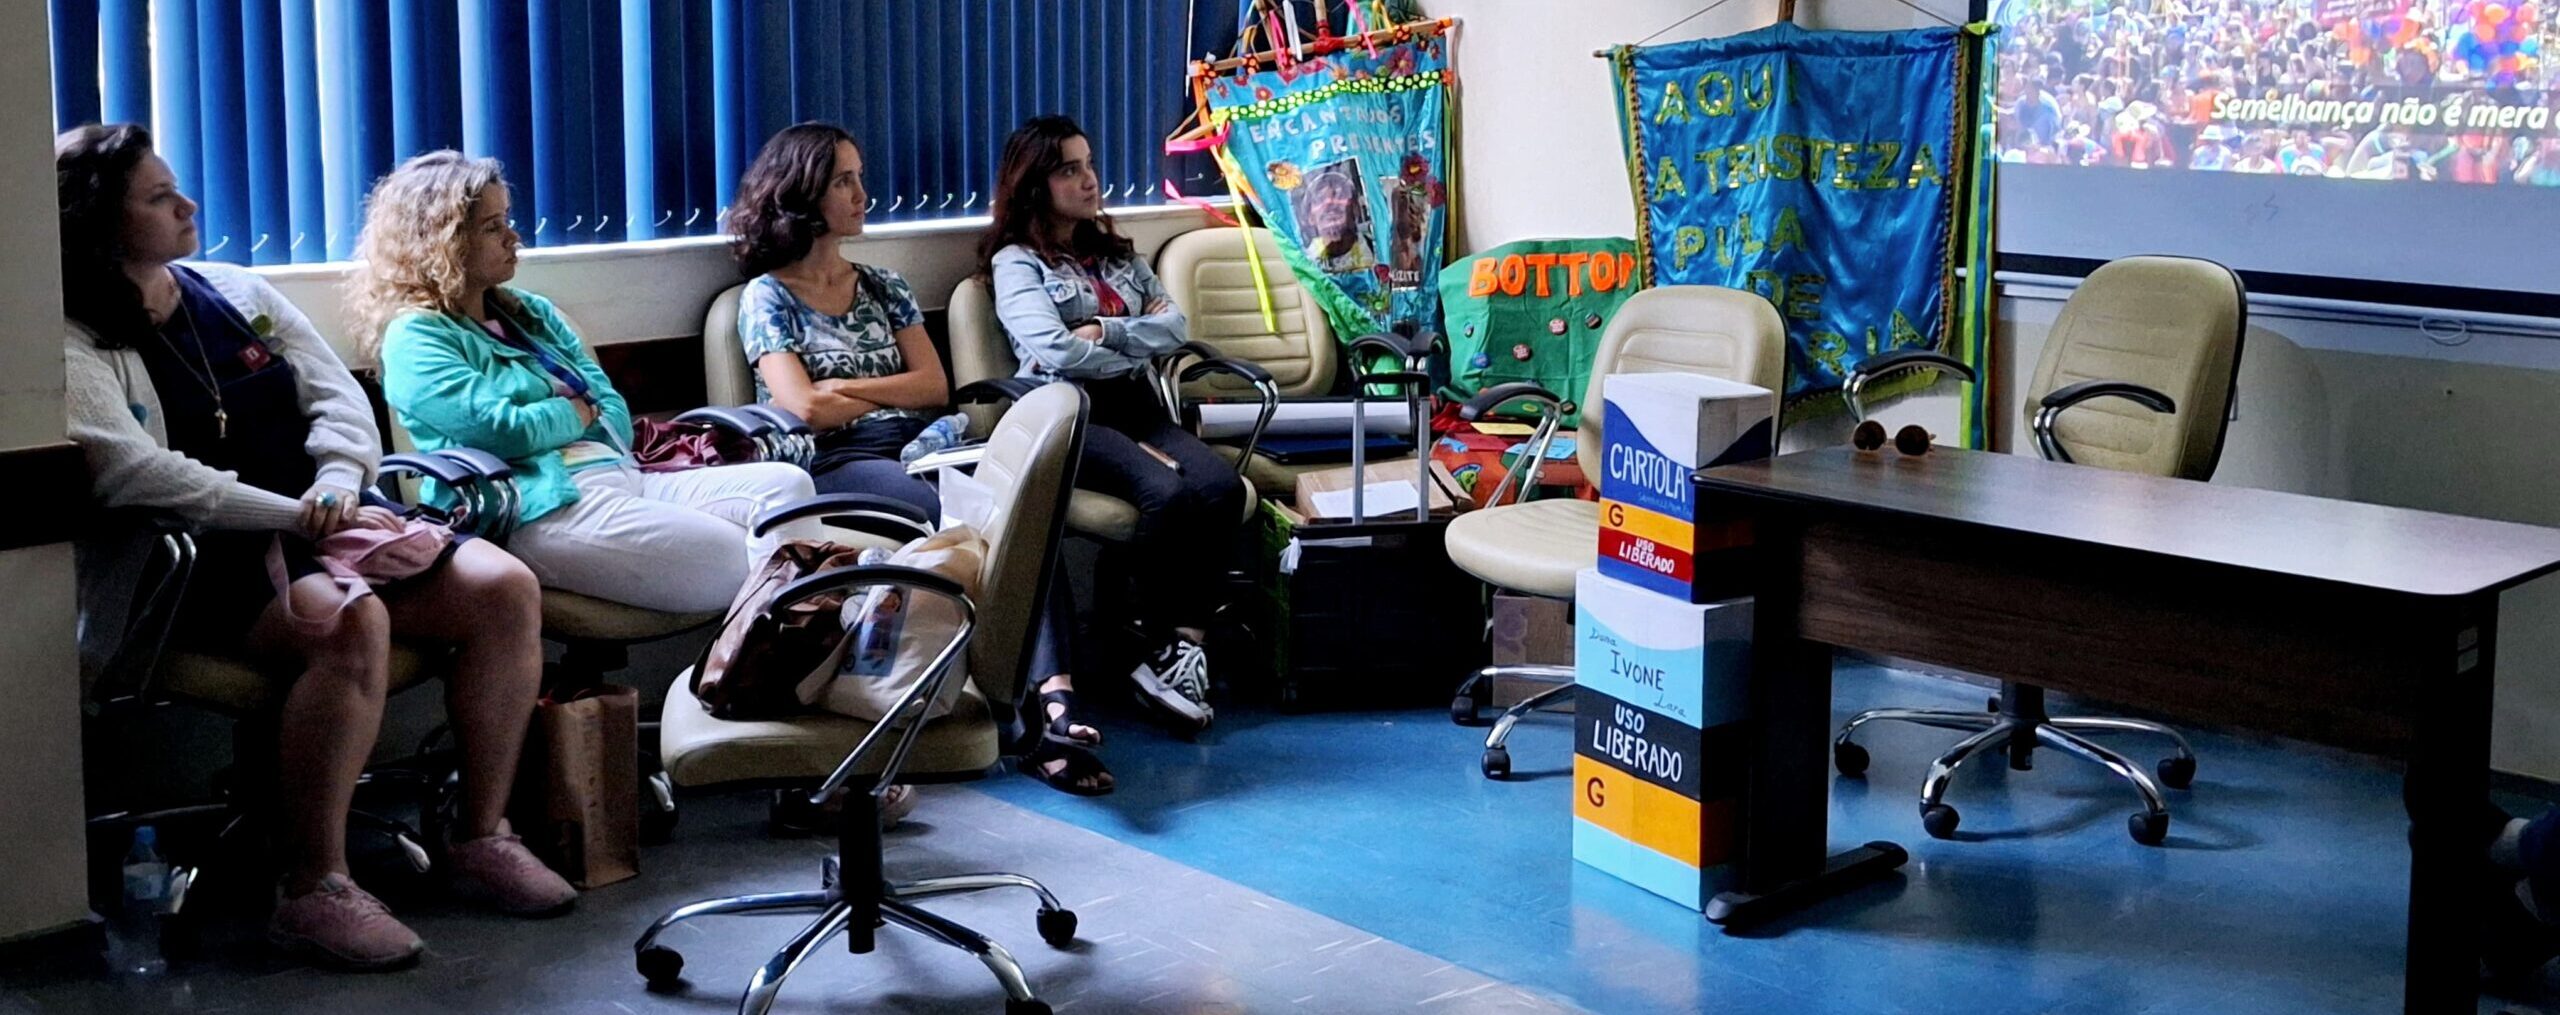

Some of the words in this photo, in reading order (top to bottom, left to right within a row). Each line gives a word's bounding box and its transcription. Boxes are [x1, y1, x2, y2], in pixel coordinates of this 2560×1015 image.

[1653, 62, 1797, 126] AQUI
[2210, 93, 2374, 129] Semelhança
[2380, 97, 2436, 126] não
[2442, 97, 2463, 127] é
[2467, 104, 2549, 129] mera
[1654, 156, 1687, 201] A
[1695, 134, 1943, 195] TRISTEZA
[1745, 269, 1825, 320] DE
[1609, 443, 1686, 502] CARTOLA
[1608, 504, 1624, 527] G
[1619, 541, 1675, 574] LIBERADO
[1635, 537, 1655, 552] USO
[1610, 649, 1666, 692] IVONE
[1614, 703, 1645, 734] USO
[1653, 694, 1687, 718] Lara
[1593, 720, 1682, 783] LIBERADO
[1587, 776, 1605, 808] G
